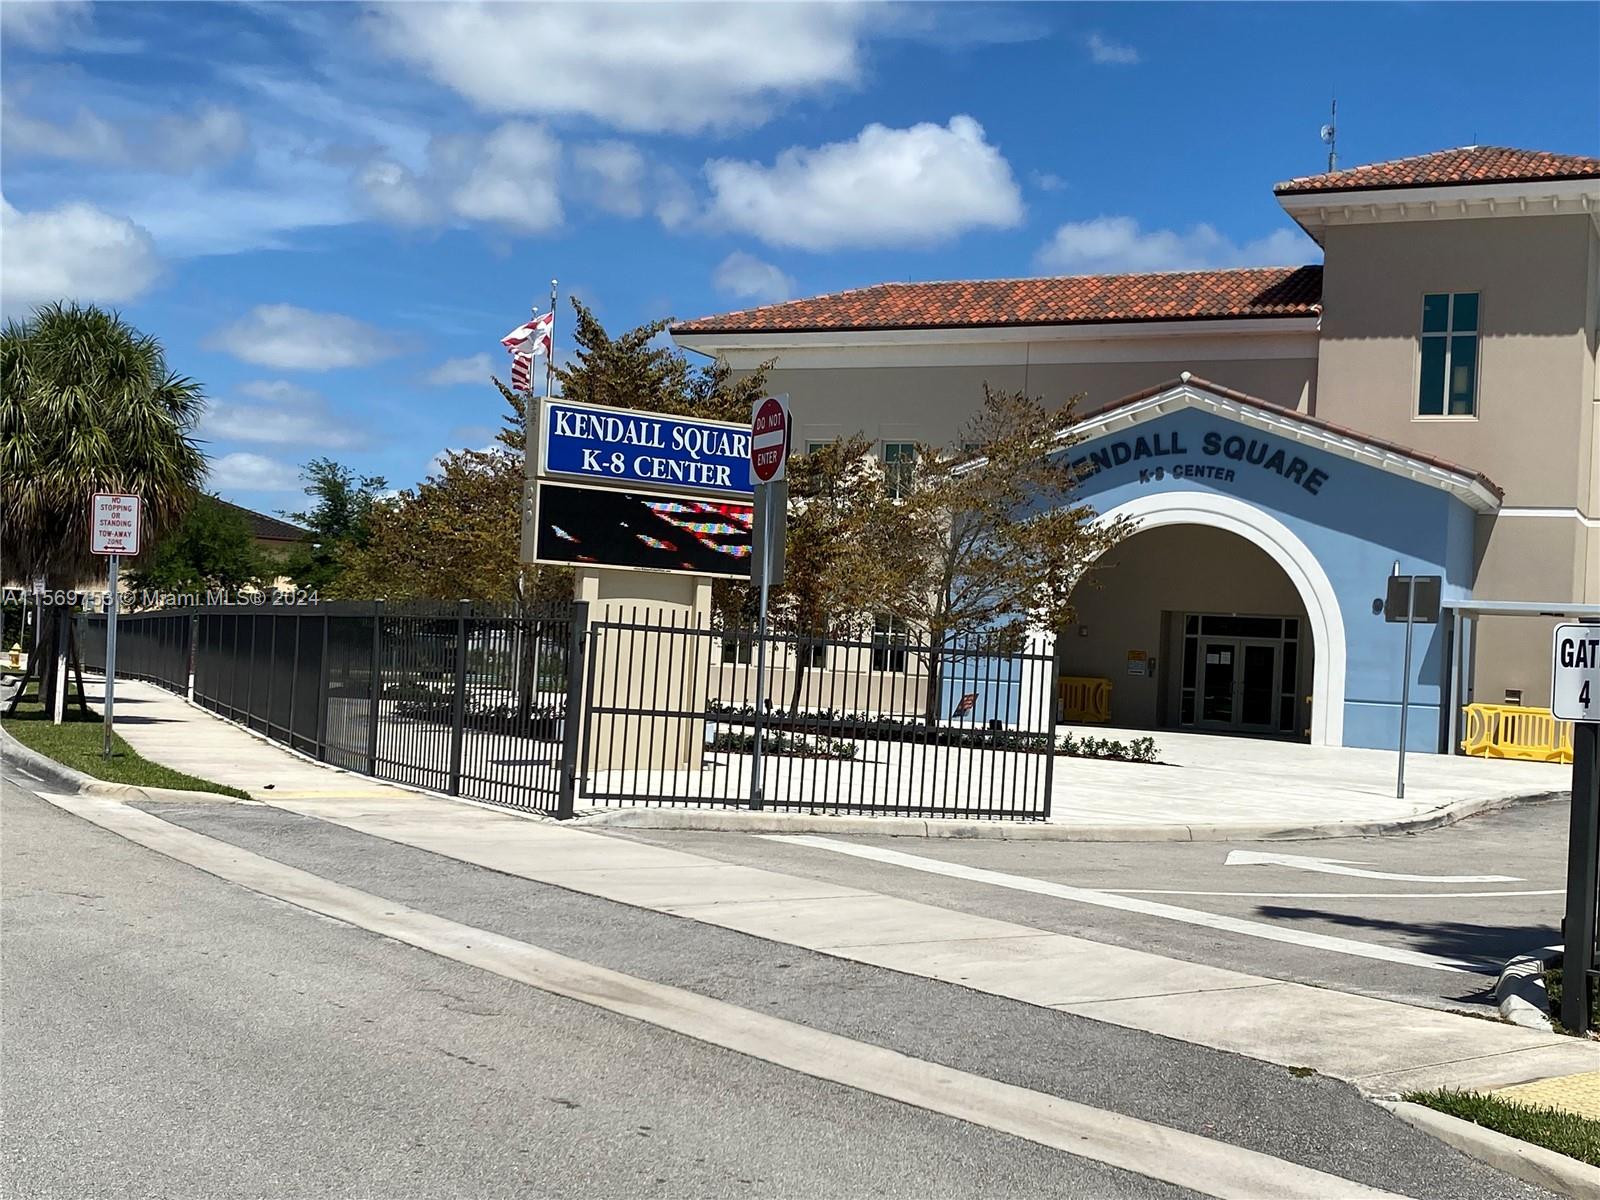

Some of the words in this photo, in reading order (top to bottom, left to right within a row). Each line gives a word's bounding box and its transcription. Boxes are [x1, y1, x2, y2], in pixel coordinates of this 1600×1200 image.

[756, 416, 766, 431] DO
[768, 412, 782, 429] NOT
[554, 410, 666, 449] KENDALL
[671, 425, 752, 460] SQUAR
[581, 448, 626, 475] K-8
[633, 455, 733, 487] CENTER
[757, 450, 778, 466] ENTER
[1055, 431, 1188, 482] ENDALL
[1202, 431, 1330, 496] SQUARE
[1139, 465, 1164, 485] K-8
[1172, 464, 1236, 483] CENTER
[100, 504, 132, 512] STOPPING
[99, 519, 132, 527] STANDING
[99, 530, 132, 538] TOW-AWAY
[1560, 638, 1600, 669] GAT
[1578, 679, 1591, 709] 4
